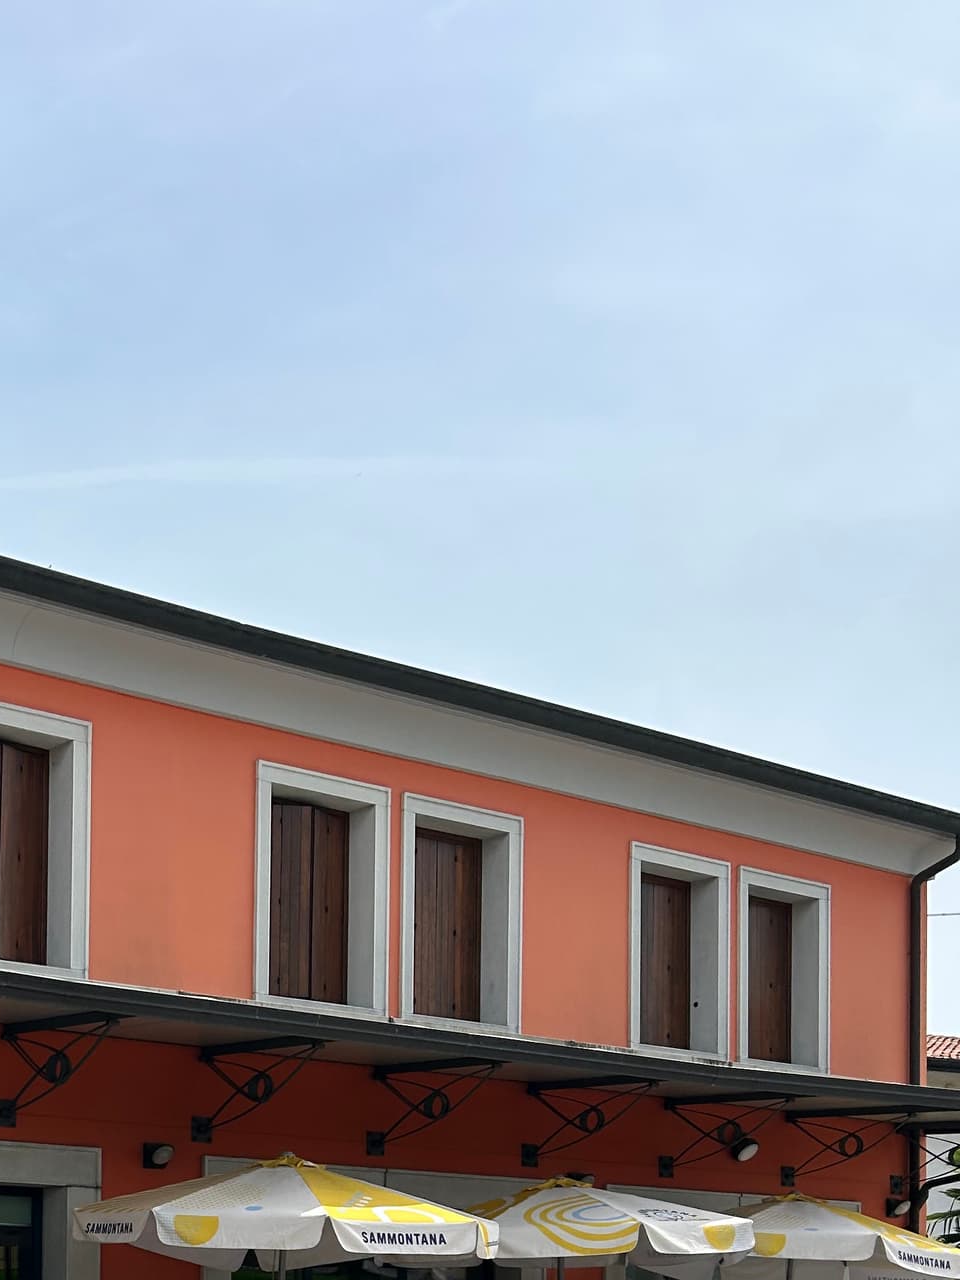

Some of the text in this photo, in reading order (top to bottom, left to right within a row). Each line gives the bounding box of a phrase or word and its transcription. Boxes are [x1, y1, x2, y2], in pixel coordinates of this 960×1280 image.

[85, 1222, 133, 1234] SAMMONTANA
[361, 1231, 447, 1246] SAMMONTANA
[898, 1250, 951, 1270] SAMMONTANA
